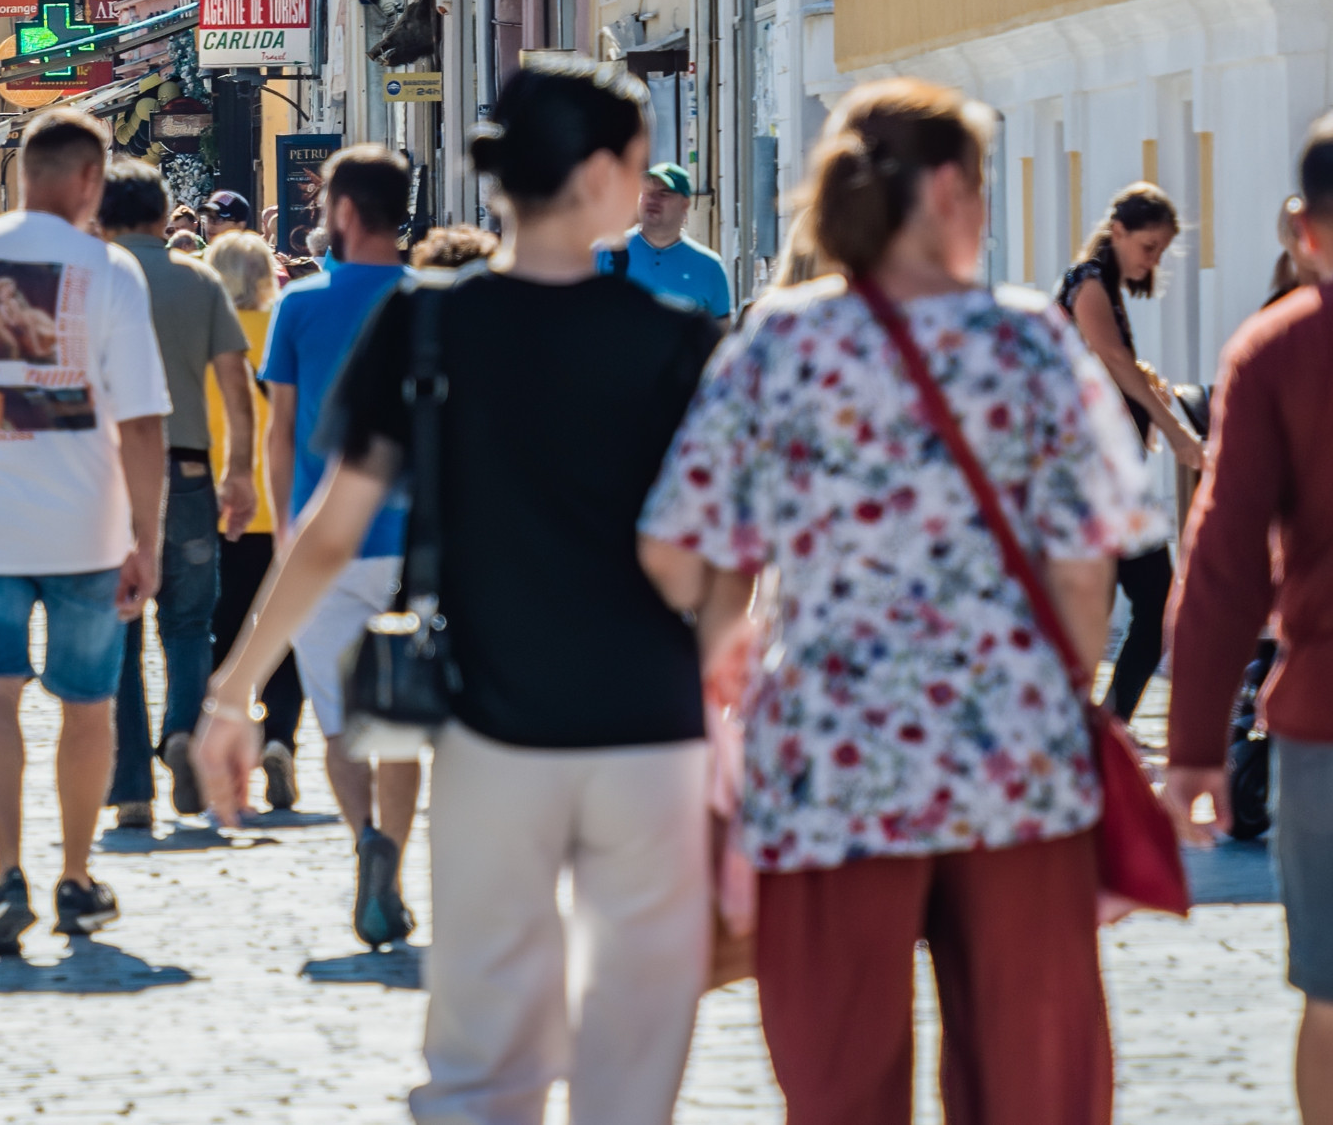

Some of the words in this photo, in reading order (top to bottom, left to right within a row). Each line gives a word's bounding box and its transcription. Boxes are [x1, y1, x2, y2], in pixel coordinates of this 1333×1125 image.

[0, 4, 37, 15] orange
[204, 30, 285, 50] CARLIDA
[261, 52, 287, 61] Travel
